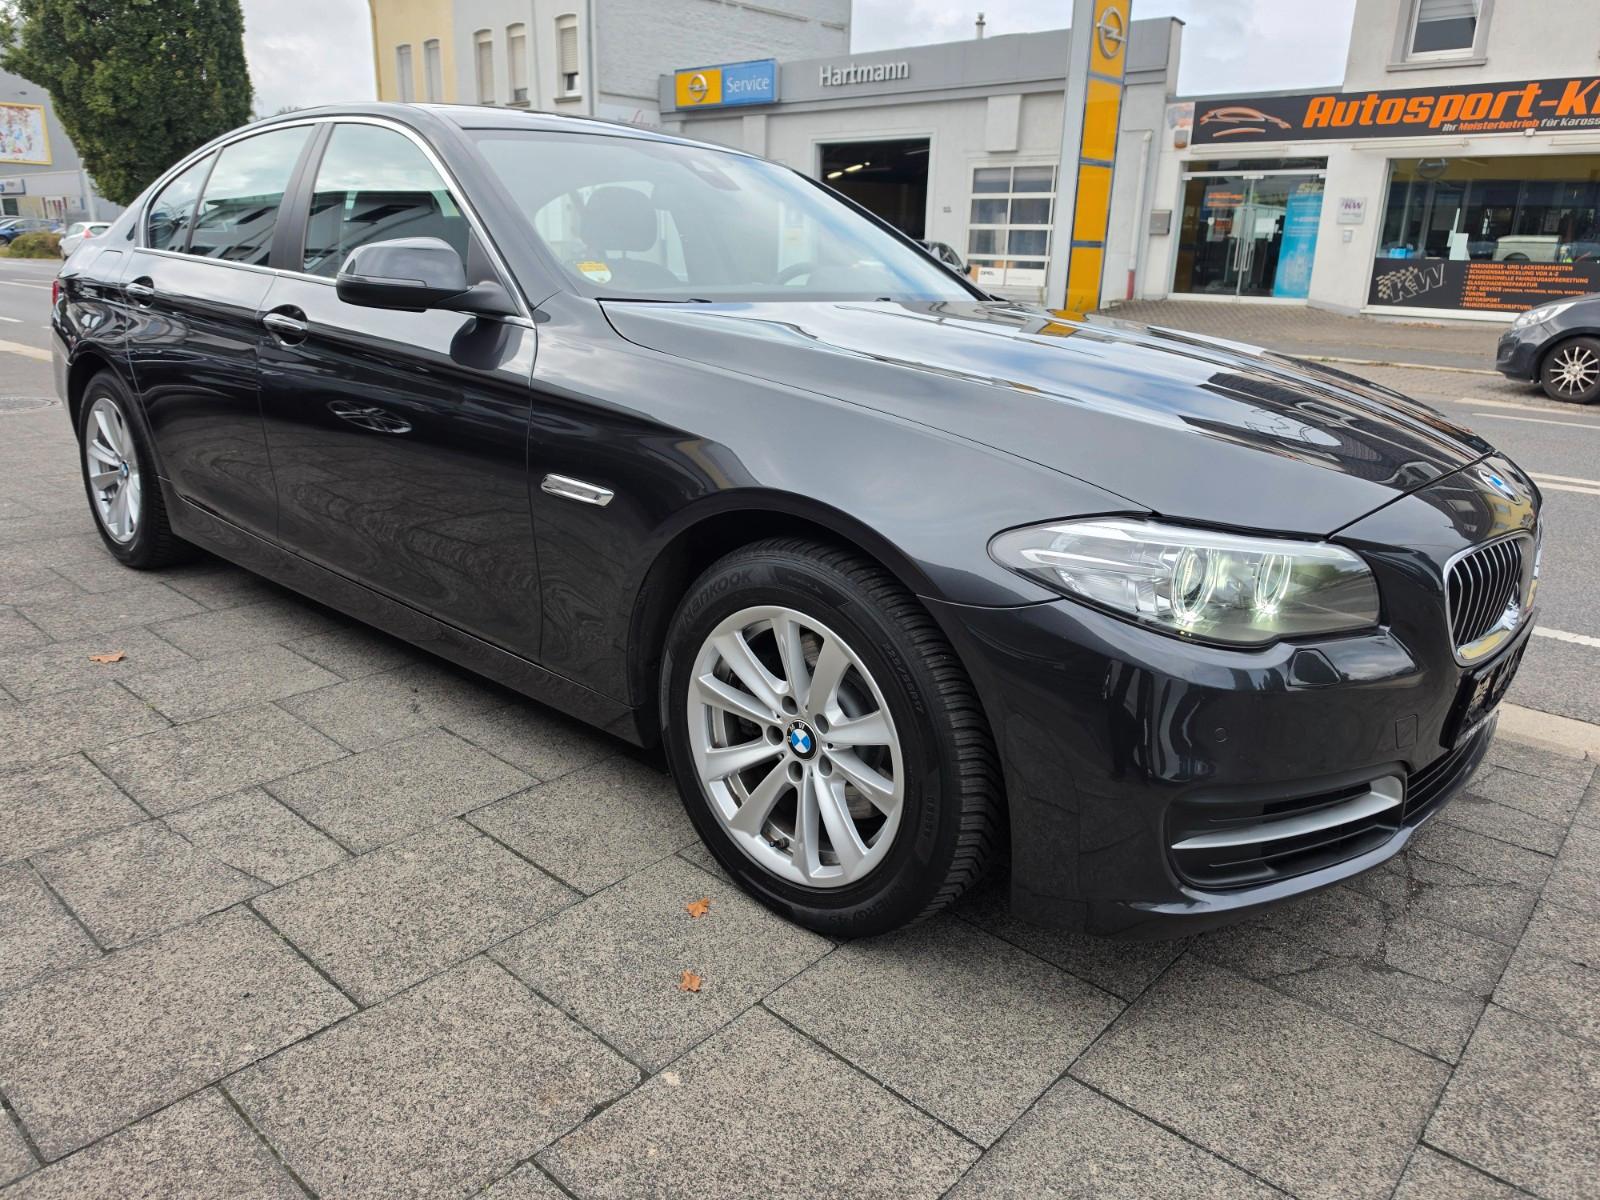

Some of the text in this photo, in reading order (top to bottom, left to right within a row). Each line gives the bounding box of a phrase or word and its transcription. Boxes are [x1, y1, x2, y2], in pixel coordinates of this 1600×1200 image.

[819, 61, 909, 87] Hartmann
[726, 77, 770, 93] Service
[1442, 123, 1457, 132] Ihr
[1458, 119, 1540, 131] Meisterbetrieb
[1540, 118, 1558, 127] für
[1389, 263, 1444, 303] KW
